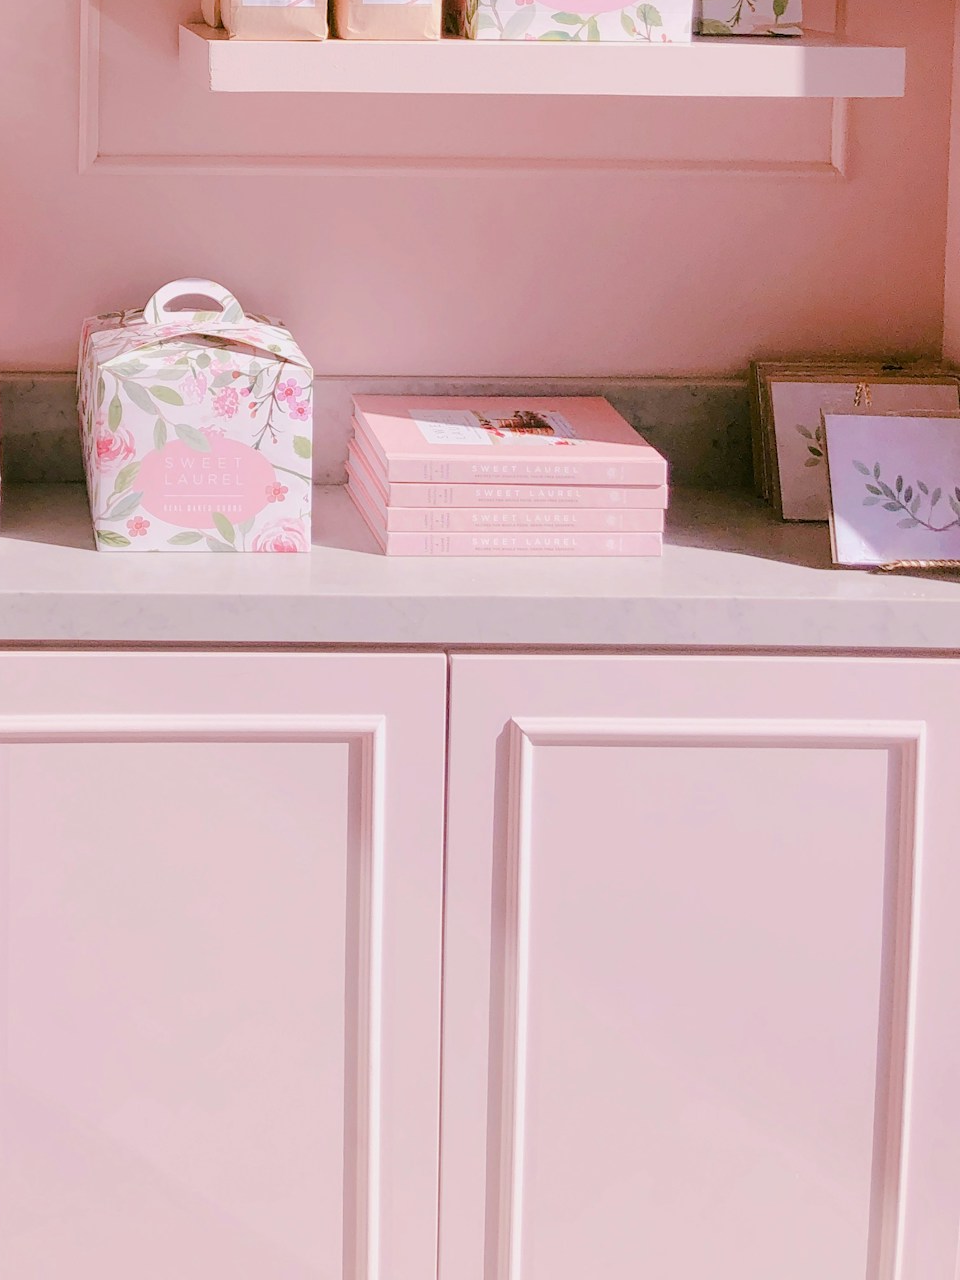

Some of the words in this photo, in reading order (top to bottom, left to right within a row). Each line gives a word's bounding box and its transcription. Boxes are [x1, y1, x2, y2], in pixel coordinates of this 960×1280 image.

[164, 457, 242, 469] SWEET
[472, 465, 517, 473] SWEET
[526, 465, 578, 473] LAUREL
[164, 473, 245, 486] LAUREL
[475, 489, 520, 497] SWEET
[529, 489, 582, 497] LAUREL
[472, 538, 517, 546] SWEET
[526, 538, 577, 546] LAUREL
